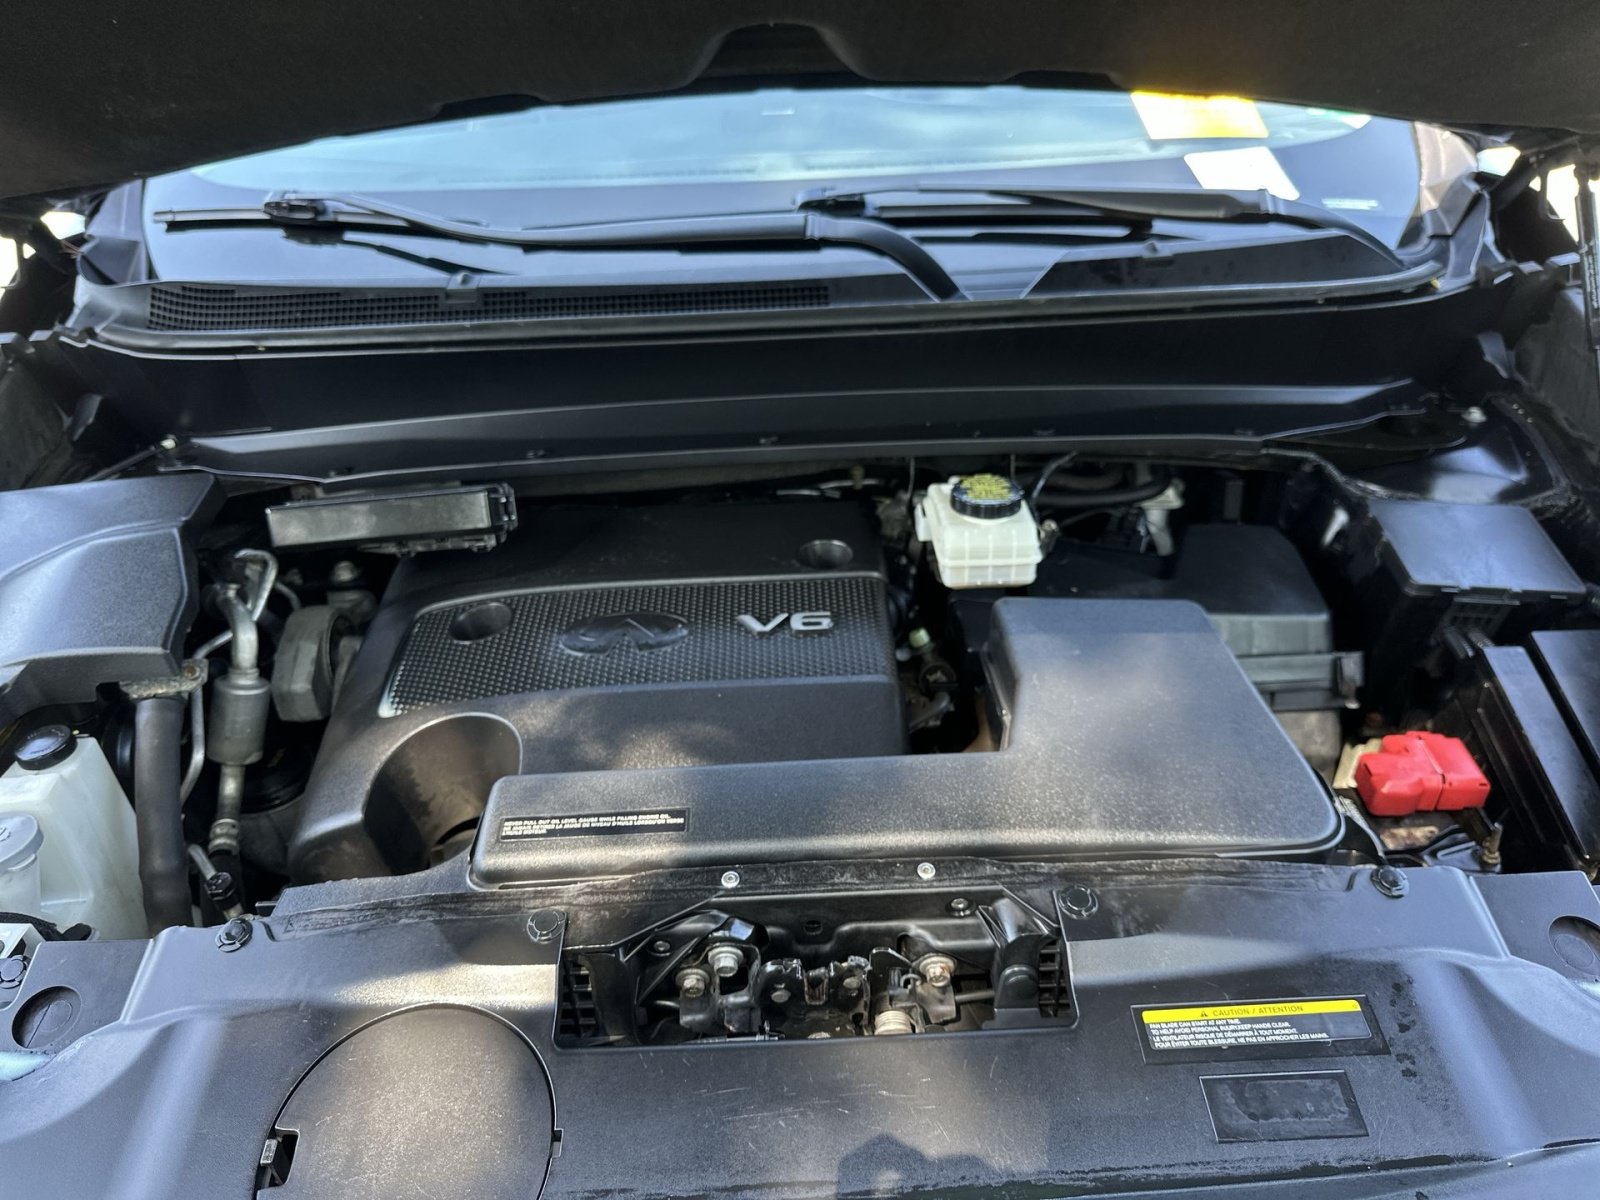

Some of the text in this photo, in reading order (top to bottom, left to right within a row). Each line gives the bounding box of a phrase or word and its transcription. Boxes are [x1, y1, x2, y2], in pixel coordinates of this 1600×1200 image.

[737, 611, 833, 632] V6
[1212, 1008, 1250, 1016] CAUTION
[1259, 1005, 1304, 1014] ATTENTION
